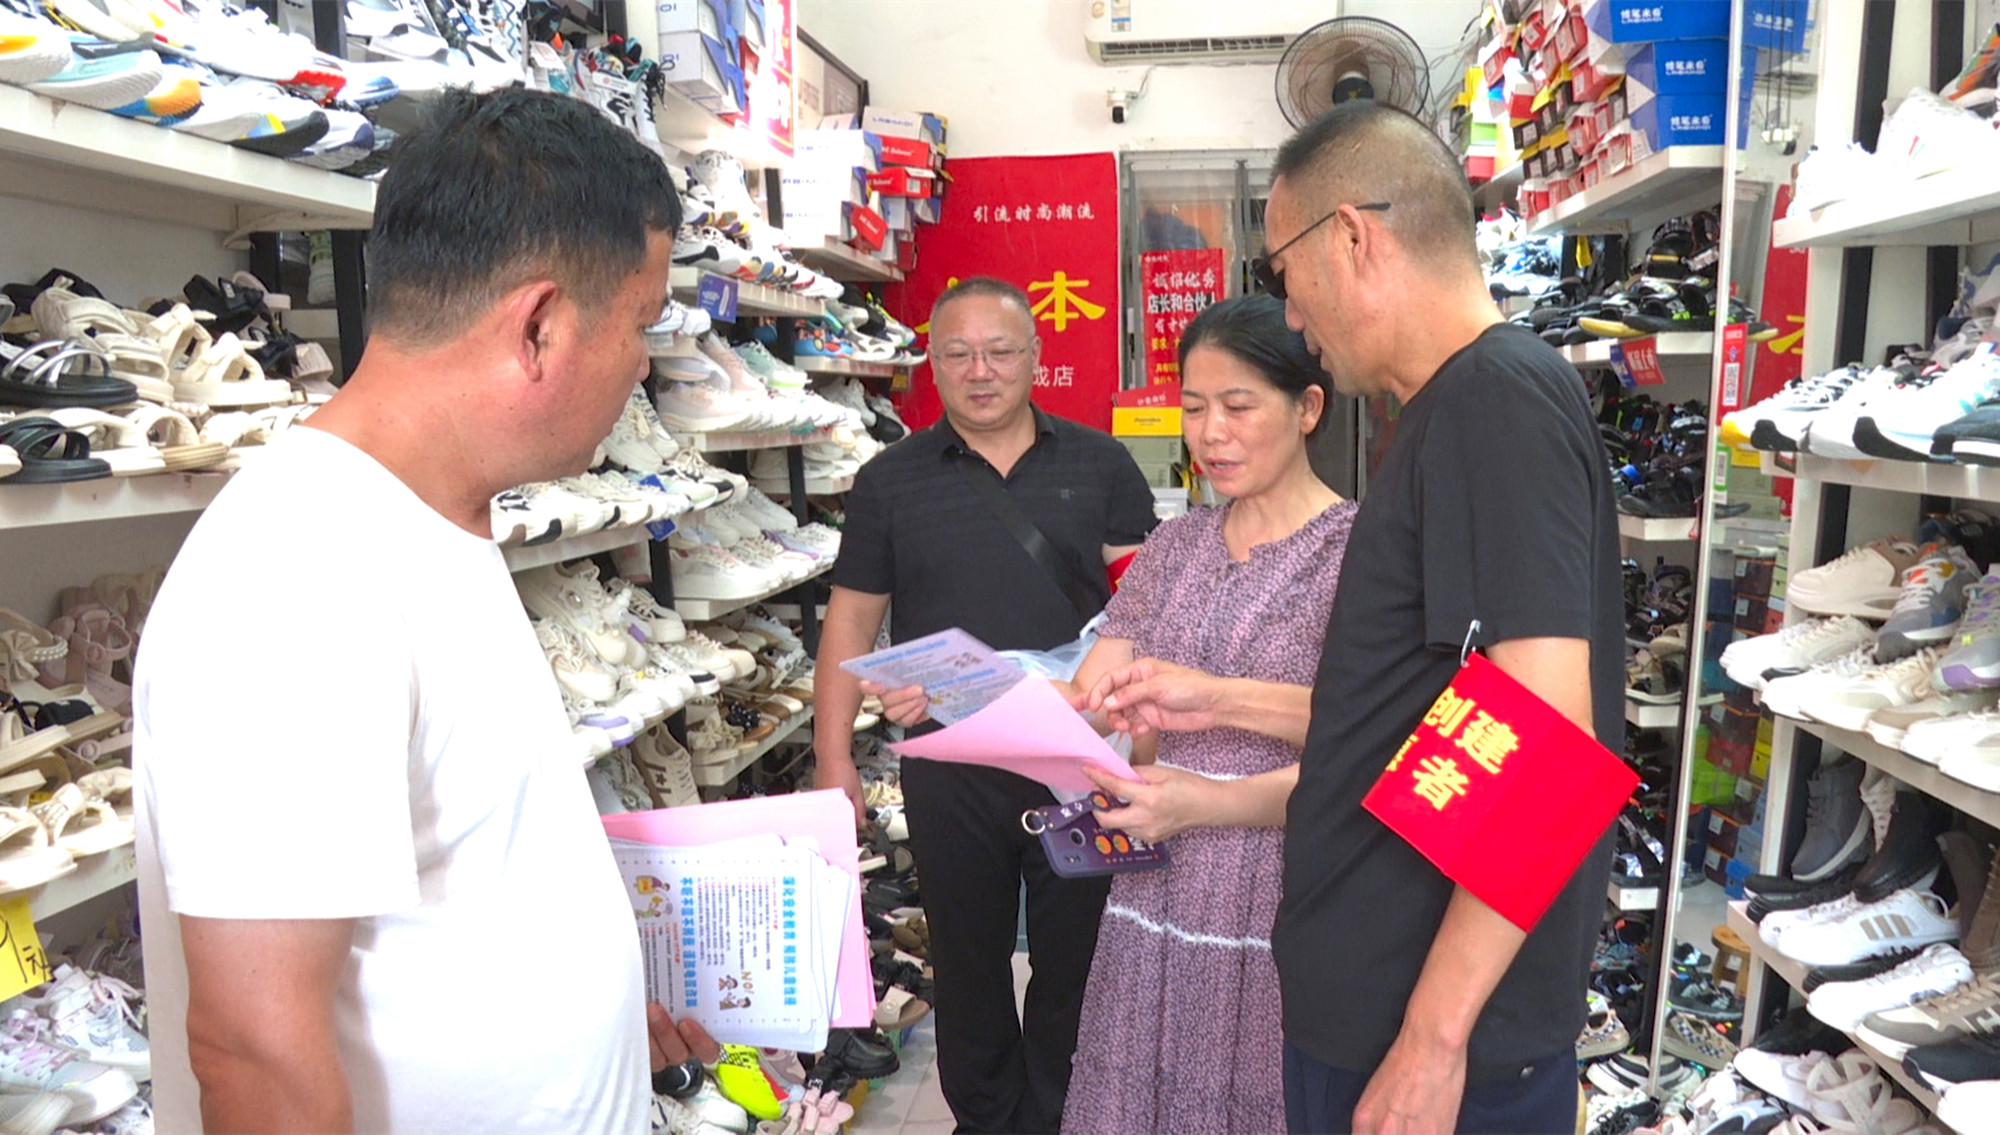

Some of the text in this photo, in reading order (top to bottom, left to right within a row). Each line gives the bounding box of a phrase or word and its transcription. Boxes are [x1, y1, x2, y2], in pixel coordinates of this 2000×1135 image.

[973, 202, 1095, 224] 引流时尚潮流
[1147, 291, 1216, 314] 店长和合伙人
